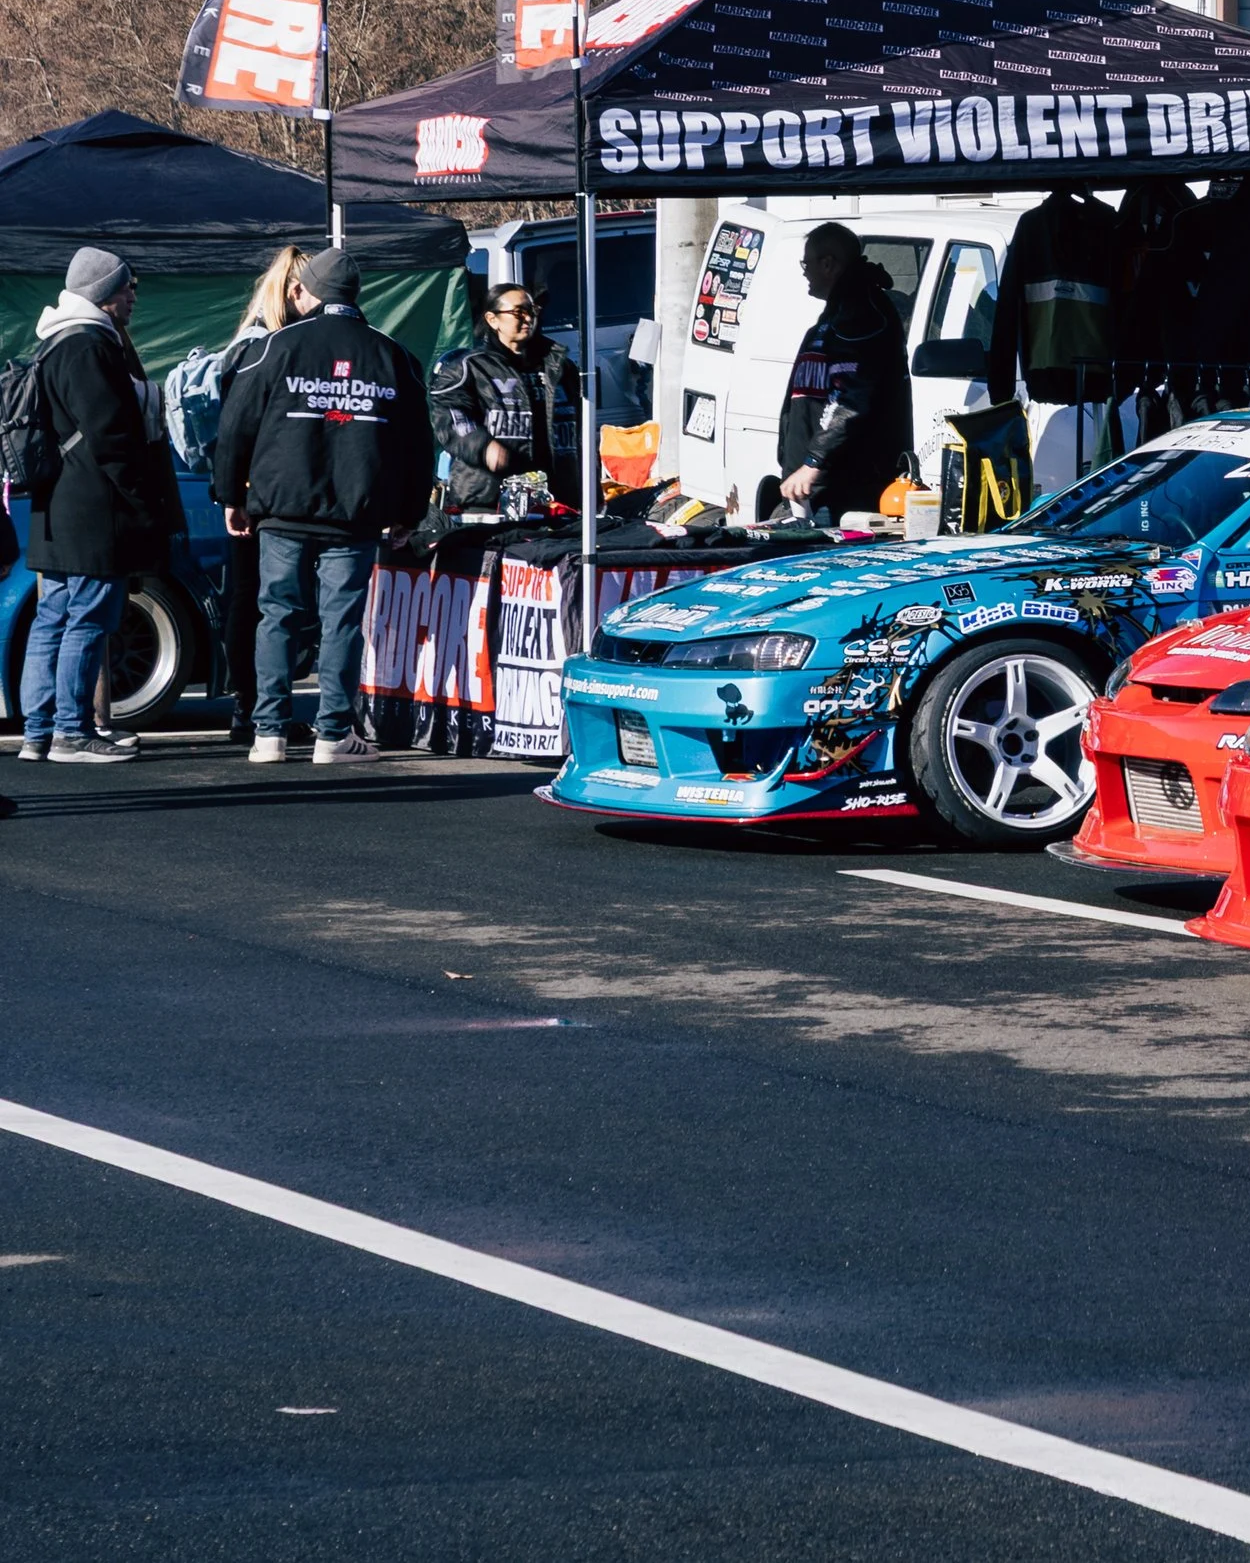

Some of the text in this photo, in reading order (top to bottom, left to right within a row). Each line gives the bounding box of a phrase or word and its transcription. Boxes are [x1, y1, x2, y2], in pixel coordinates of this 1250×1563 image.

[714, 4, 772, 20] HARDCORE
[883, 1, 940, 18] HARDCORE
[826, 18, 884, 33] HARDCORE
[769, 32, 828, 48] HARDCORE
[1049, 50, 1107, 65] HARDCORE
[994, 60, 1052, 77] HARDCORE
[599, 105, 880, 174] SUPPORT
[891, 94, 1132, 164] VIOLENT
[285, 376, 397, 400] Violent Drive
[307, 394, 374, 412] service
[1044, 577, 1134, 592] K-WORKS
[840, 793, 907, 812] SHO-RISE
